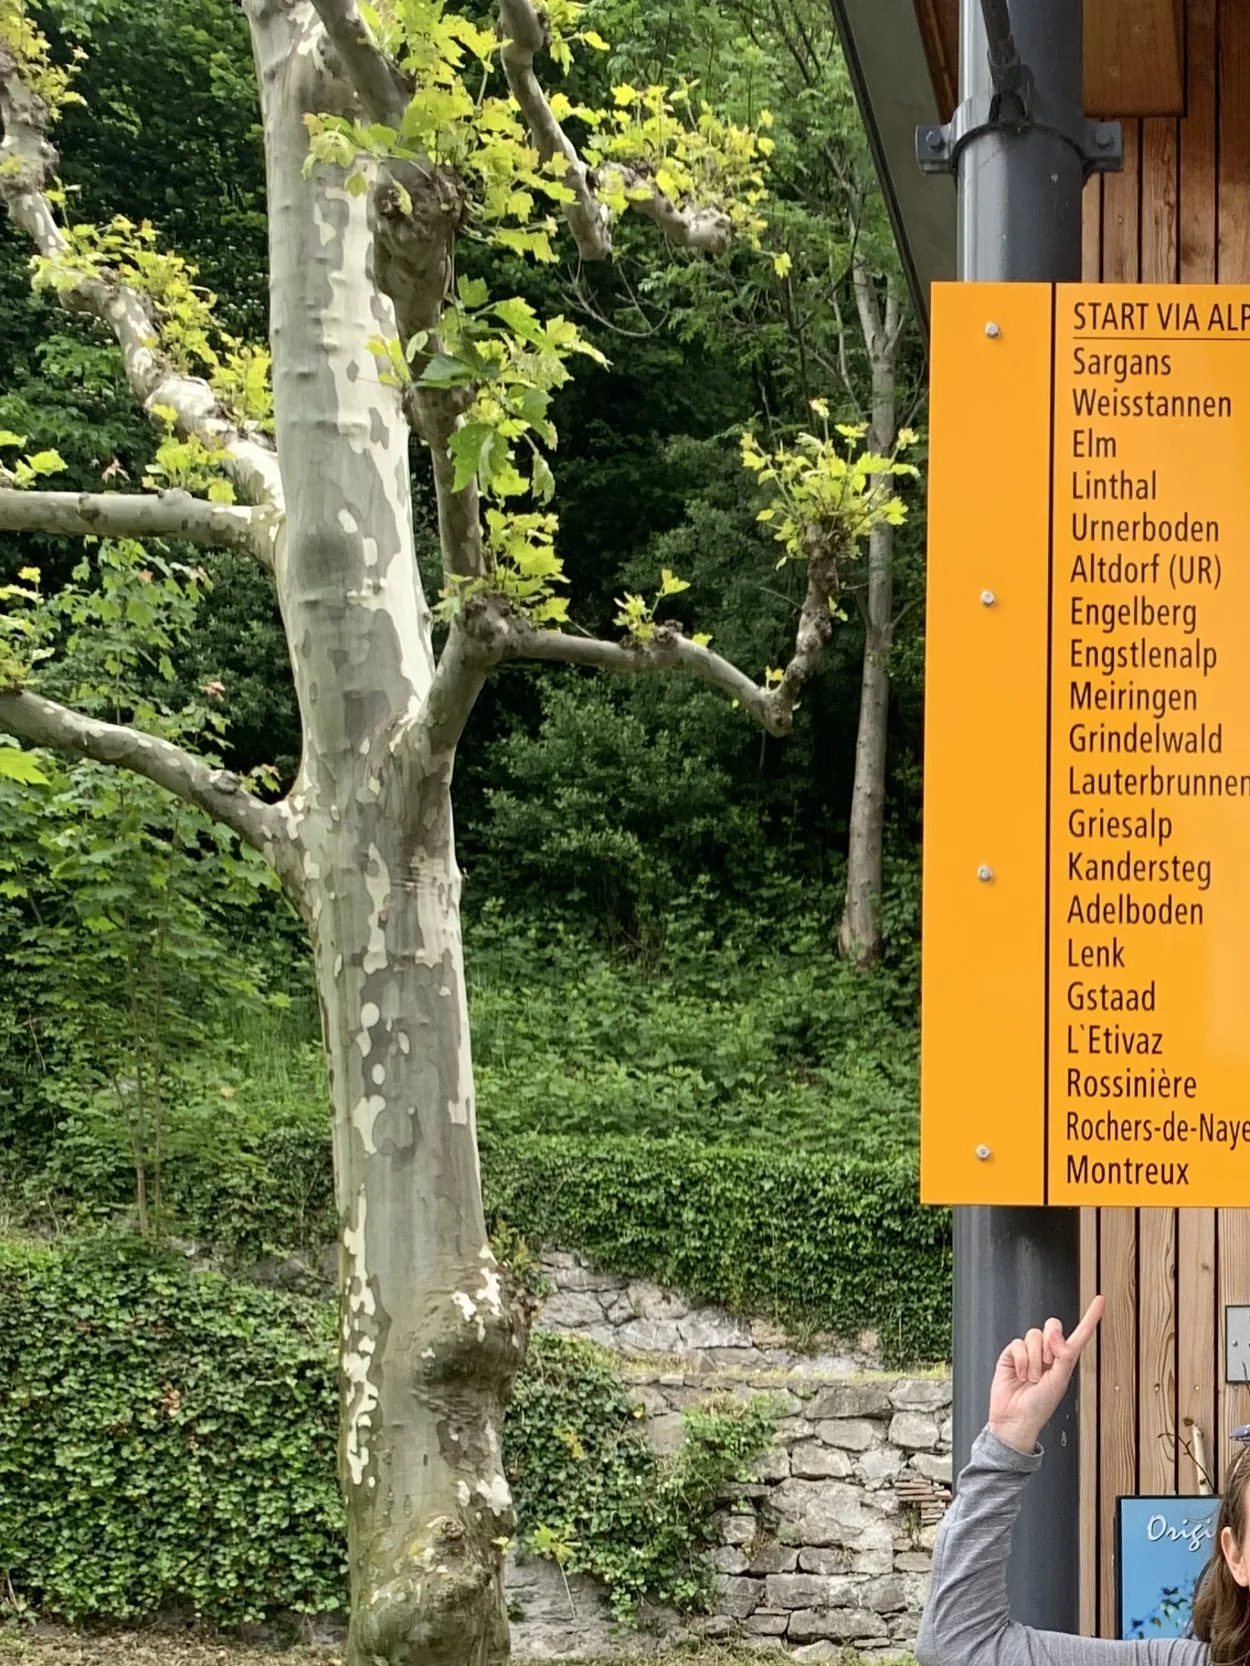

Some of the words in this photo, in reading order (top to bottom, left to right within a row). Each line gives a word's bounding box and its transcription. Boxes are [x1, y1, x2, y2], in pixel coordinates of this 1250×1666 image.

[1073, 301, 1150, 331] START
[1156, 302, 1201, 331] VIA
[1073, 346, 1172, 384] Sargans
[1072, 387, 1232, 418] Weisstannen
[1072, 427, 1117, 458] Elm
[1072, 469, 1157, 501] Linthal
[1071, 511, 1219, 542] Urnerboden
[1069, 552, 1160, 584] Altdorf
[1169, 553, 1222, 590] (UR)
[1071, 595, 1197, 635] Engelberg
[1070, 637, 1217, 677] Engstlenalp
[1070, 680, 1197, 720] Meiringen
[1069, 721, 1222, 754] Grindelwald
[1068, 807, 1173, 847] Griesalp
[1068, 850, 1211, 891] Kandersteg
[1066, 892, 1204, 925] Adelboden
[1068, 936, 1125, 968] Lenk
[1067, 980, 1156, 1012] Gstaad
[1067, 1067, 1197, 1099] Rossinière
[1066, 1154, 1190, 1185] Montreux
